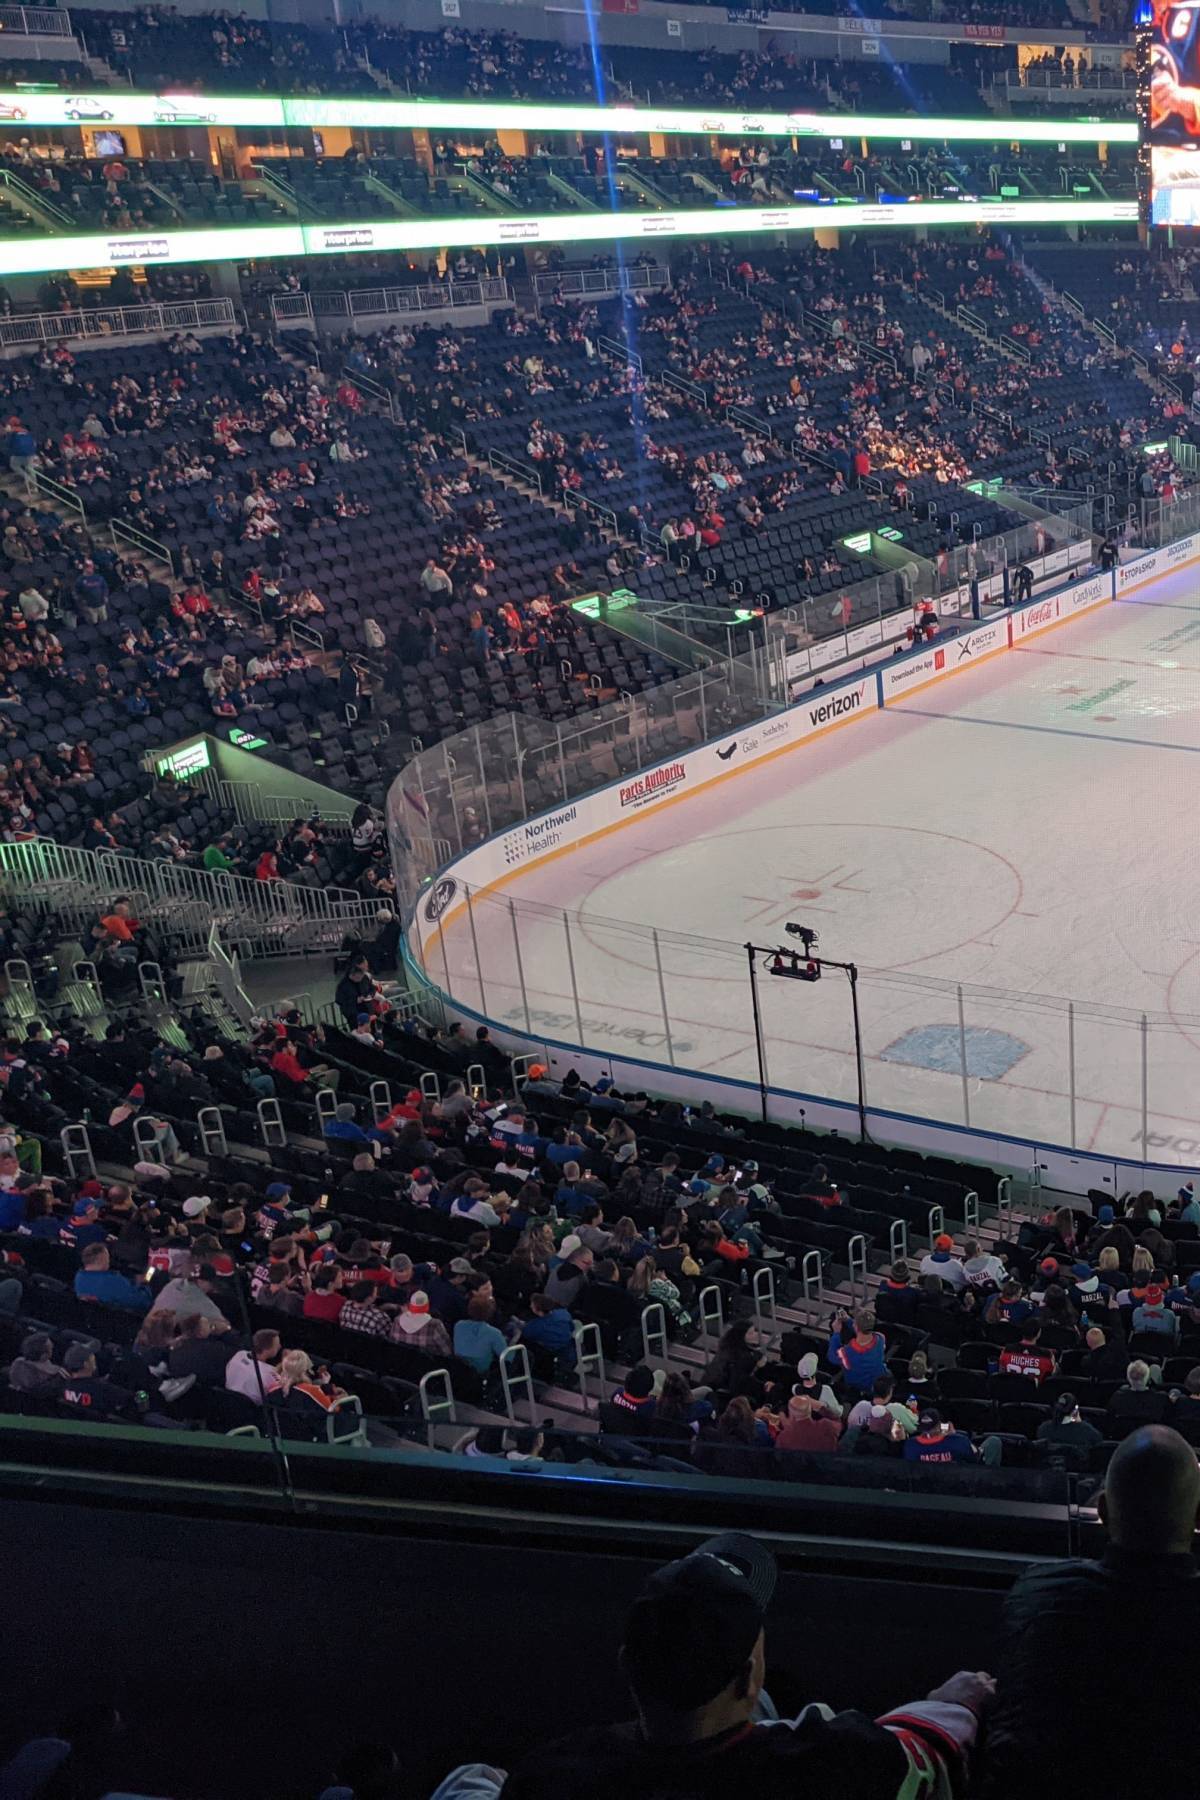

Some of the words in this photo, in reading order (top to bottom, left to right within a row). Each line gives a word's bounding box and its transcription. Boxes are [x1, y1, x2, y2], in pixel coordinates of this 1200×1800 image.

[971, 630, 997, 646] ARCTIX
[891, 667, 915, 684] Download
[915, 664, 924, 673] the
[809, 690, 860, 726] verizon
[620, 780, 644, 801] Parts
[645, 763, 685, 790] Authority
[524, 807, 577, 840] Northwell
[526, 832, 561, 856] Health
[1081, 1292, 1104, 1304] BARZAL
[1010, 1355, 1040, 1367] HUGHES
